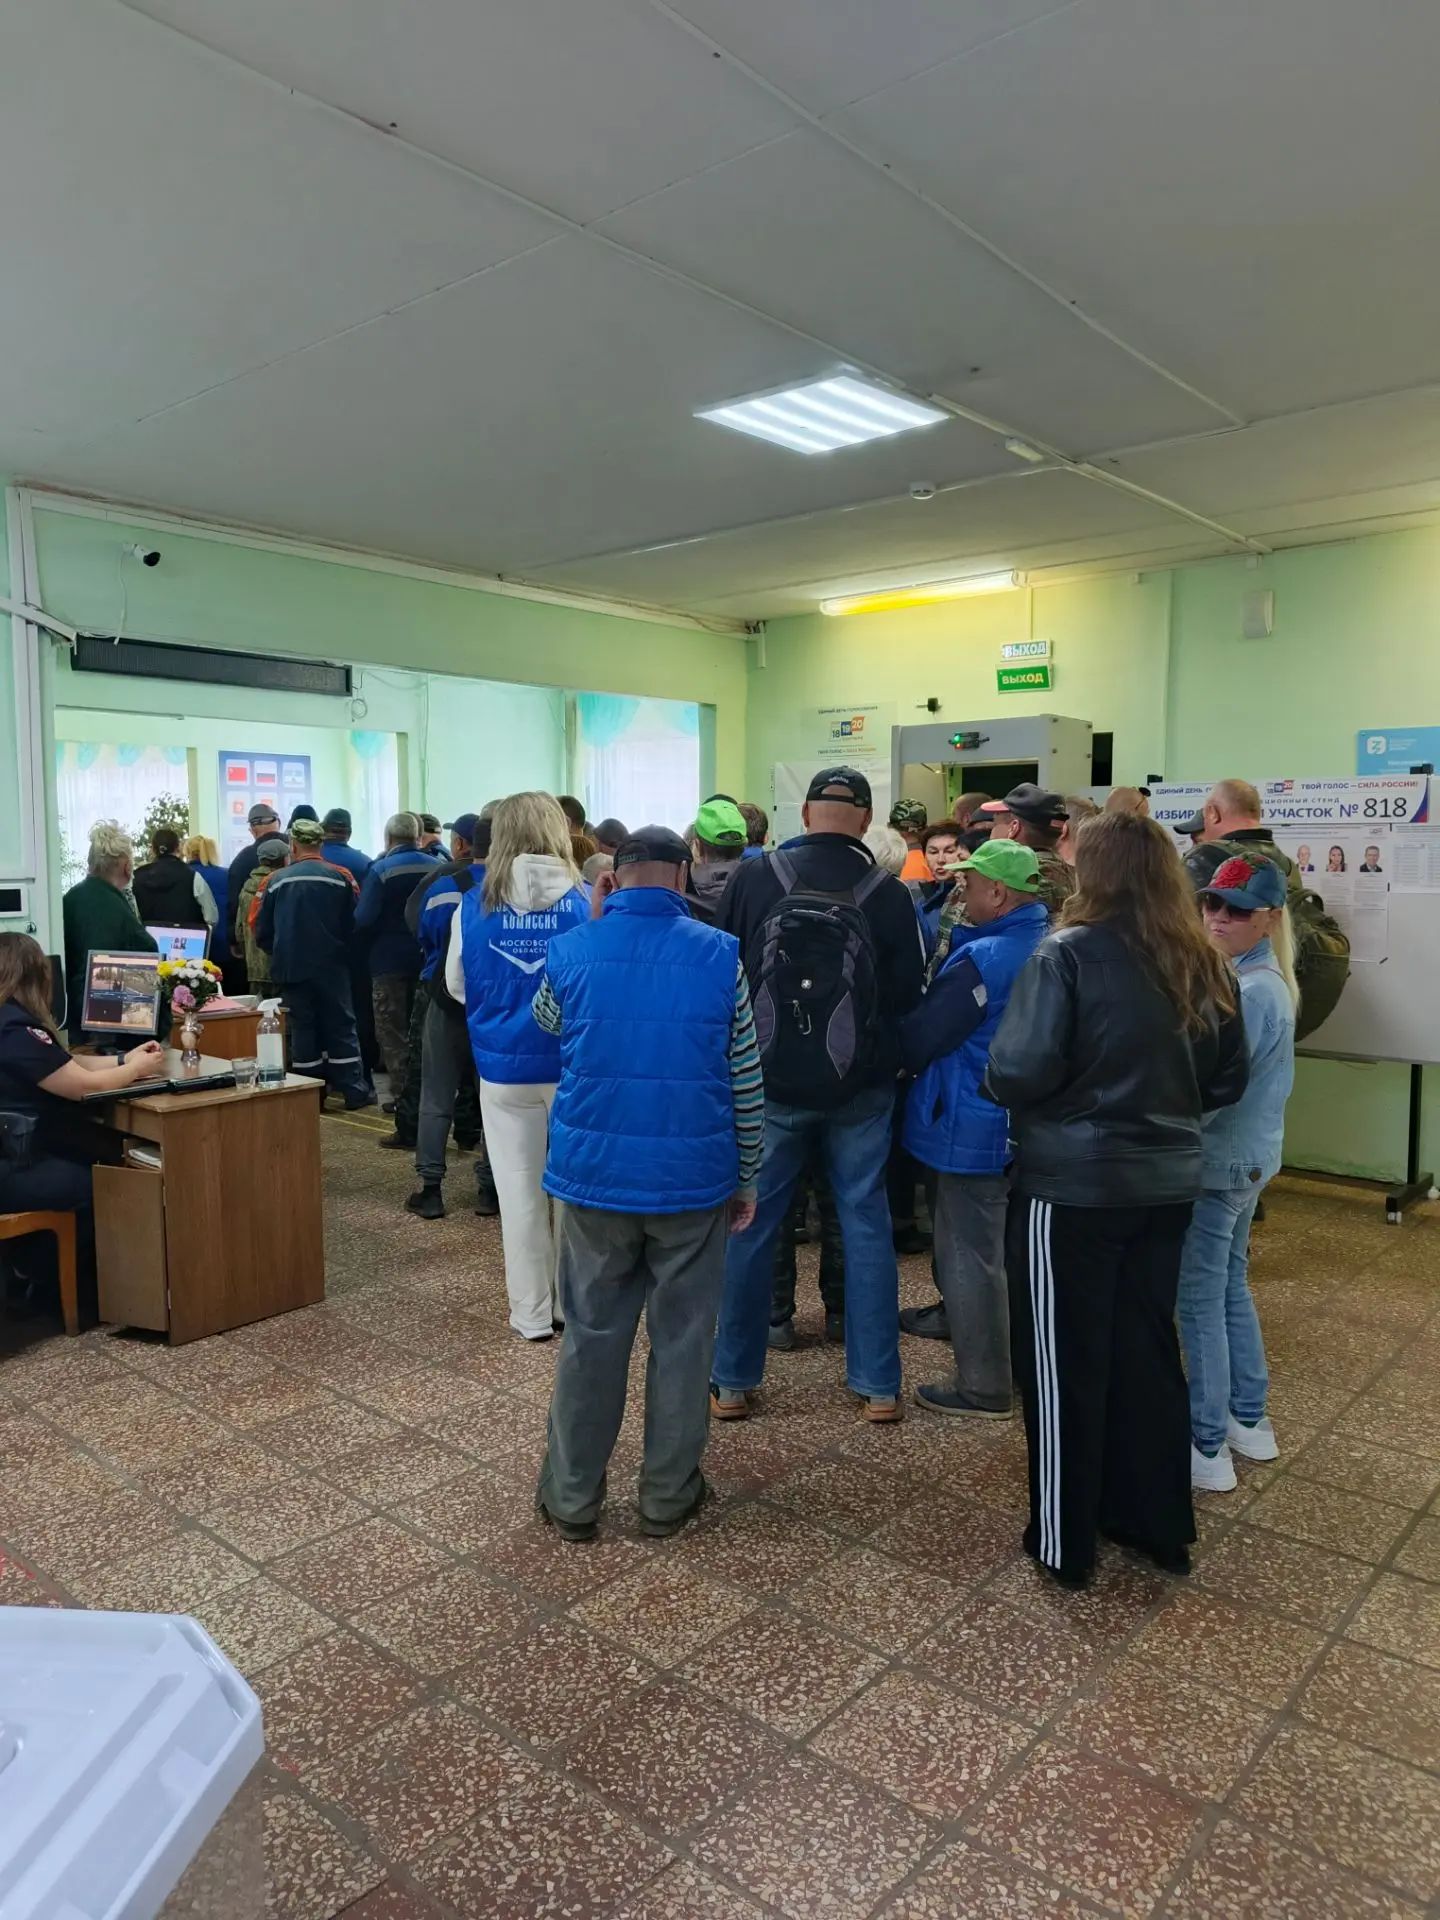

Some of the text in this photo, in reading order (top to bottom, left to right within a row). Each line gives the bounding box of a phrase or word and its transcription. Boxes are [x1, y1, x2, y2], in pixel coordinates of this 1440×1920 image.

[1004, 642, 1046, 658] ВЫХОД
[1002, 673, 1044, 684] ВЫХОД
[852, 719, 863, 729] 20
[1301, 782, 1321, 790] ТВОЙ
[1357, 781, 1380, 789] СИЛА
[1155, 797, 1407, 820] ИЗБИР УЧАСТОК № 818
[502, 914, 558, 930] КОМИССИЯ
